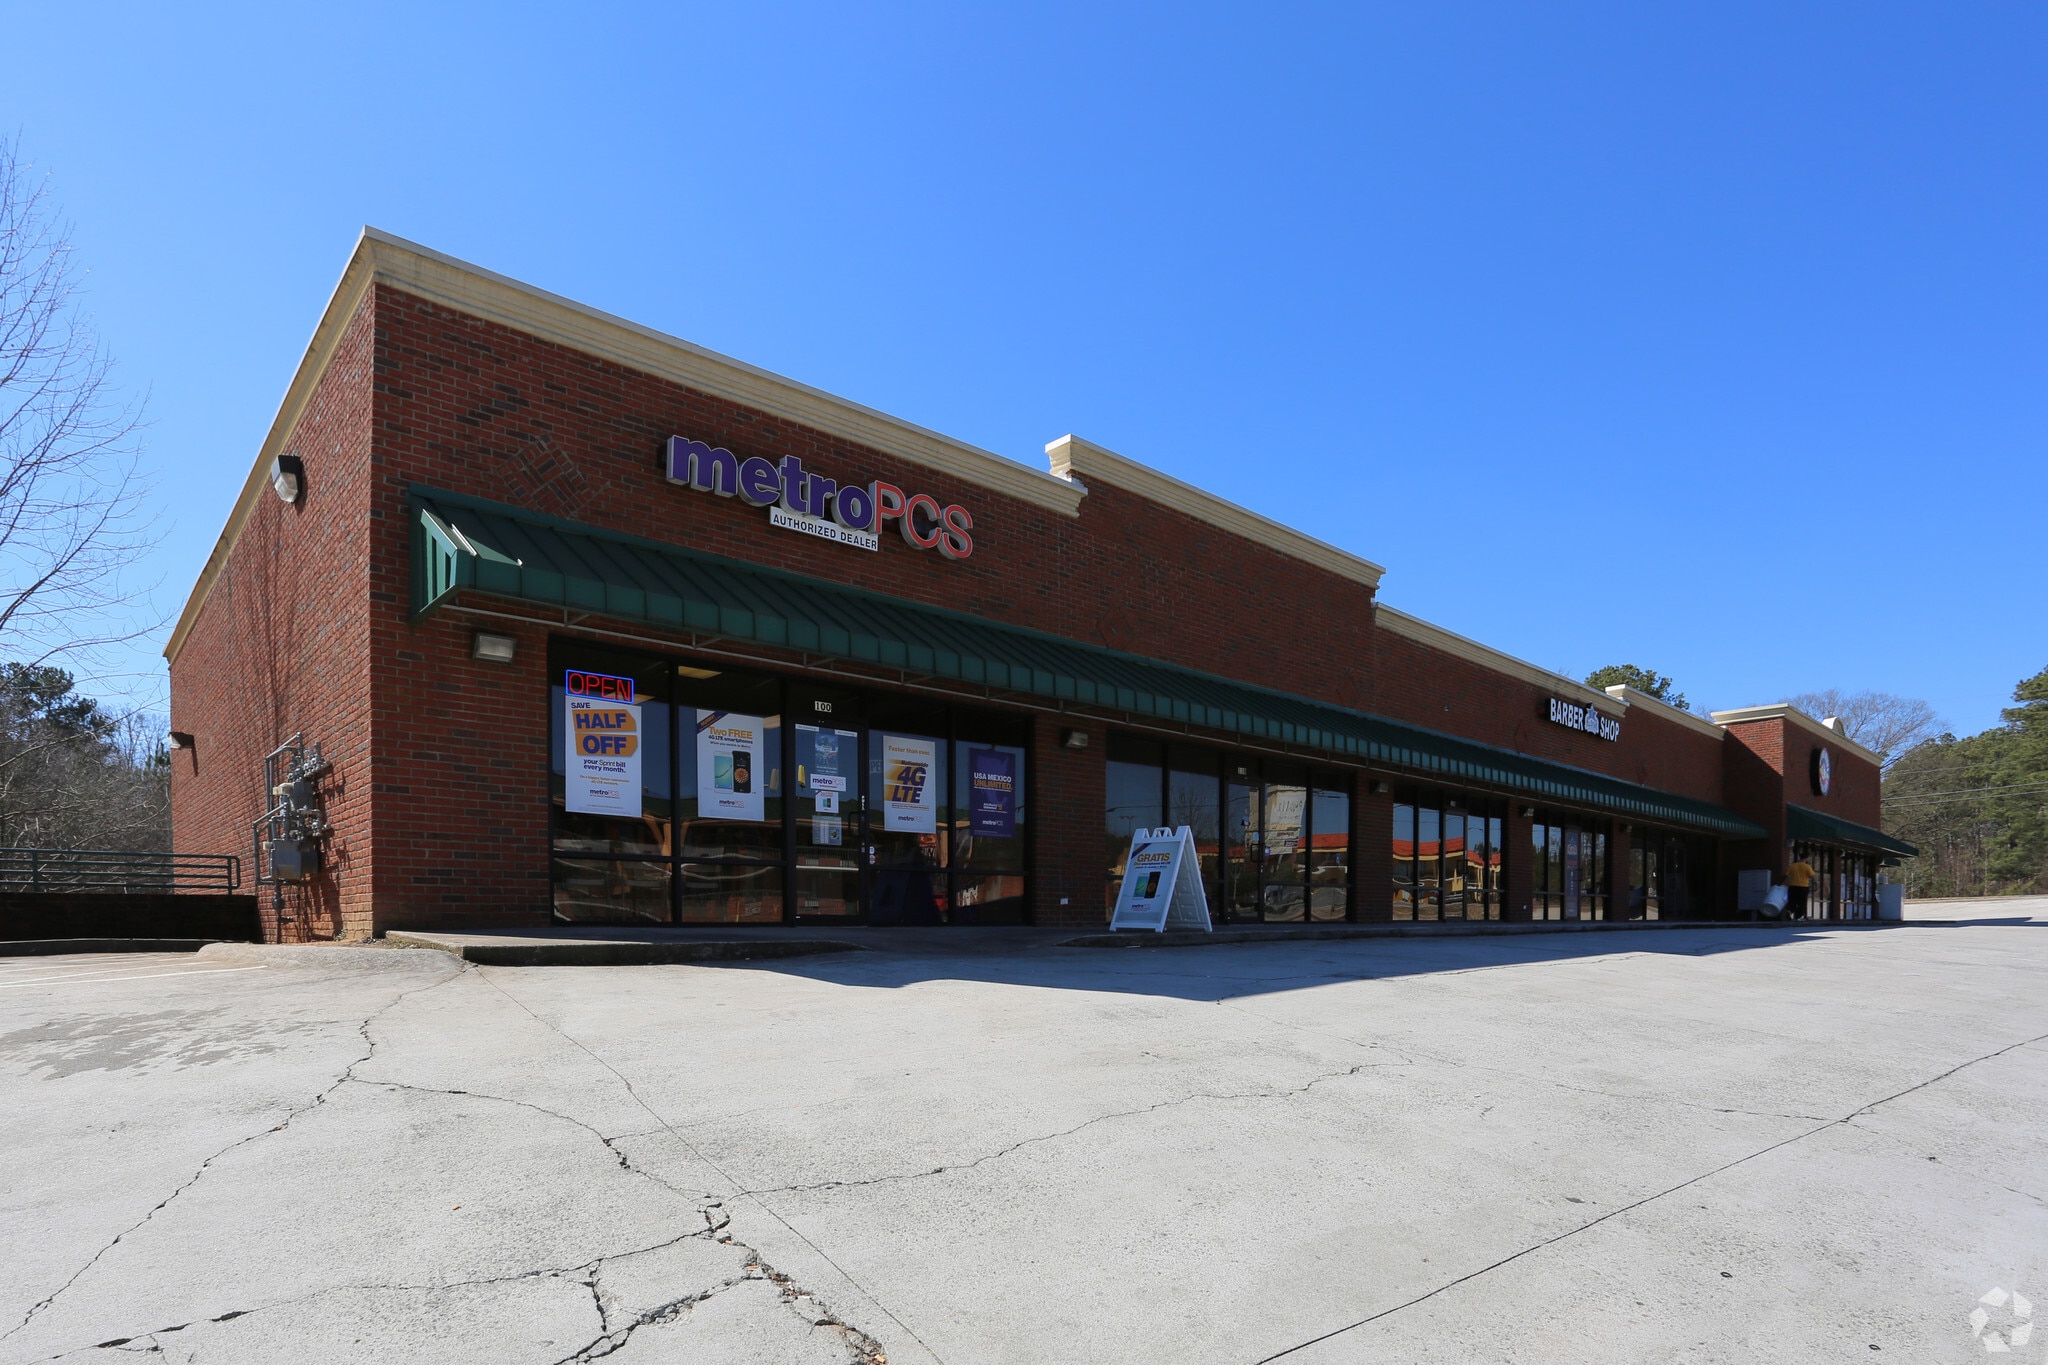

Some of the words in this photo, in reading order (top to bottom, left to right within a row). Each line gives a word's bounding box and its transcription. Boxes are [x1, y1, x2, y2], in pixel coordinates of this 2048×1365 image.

[666, 435, 973, 559] metroPCS
[773, 514, 837, 539] AUTHORIZED
[840, 531, 877, 550] DEALER
[568, 673, 631, 702] OPEN
[816, 701, 832, 712] 100
[575, 713, 627, 729] HALF
[1550, 698, 1584, 731] BARBER
[1599, 716, 1620, 742] SHOP
[709, 726, 727, 736] Two
[728, 728, 753, 740] FREE
[583, 735, 627, 755] OFF
[888, 745, 905, 753] Faster
[583, 764, 602, 772] every
[599, 759, 616, 767] Sprint
[897, 766, 927, 787] 4G
[973, 772, 987, 780] USA
[987, 774, 1012, 783] MEXICO
[891, 785, 923, 804] LTE
[1137, 852, 1171, 863] GRATIS
